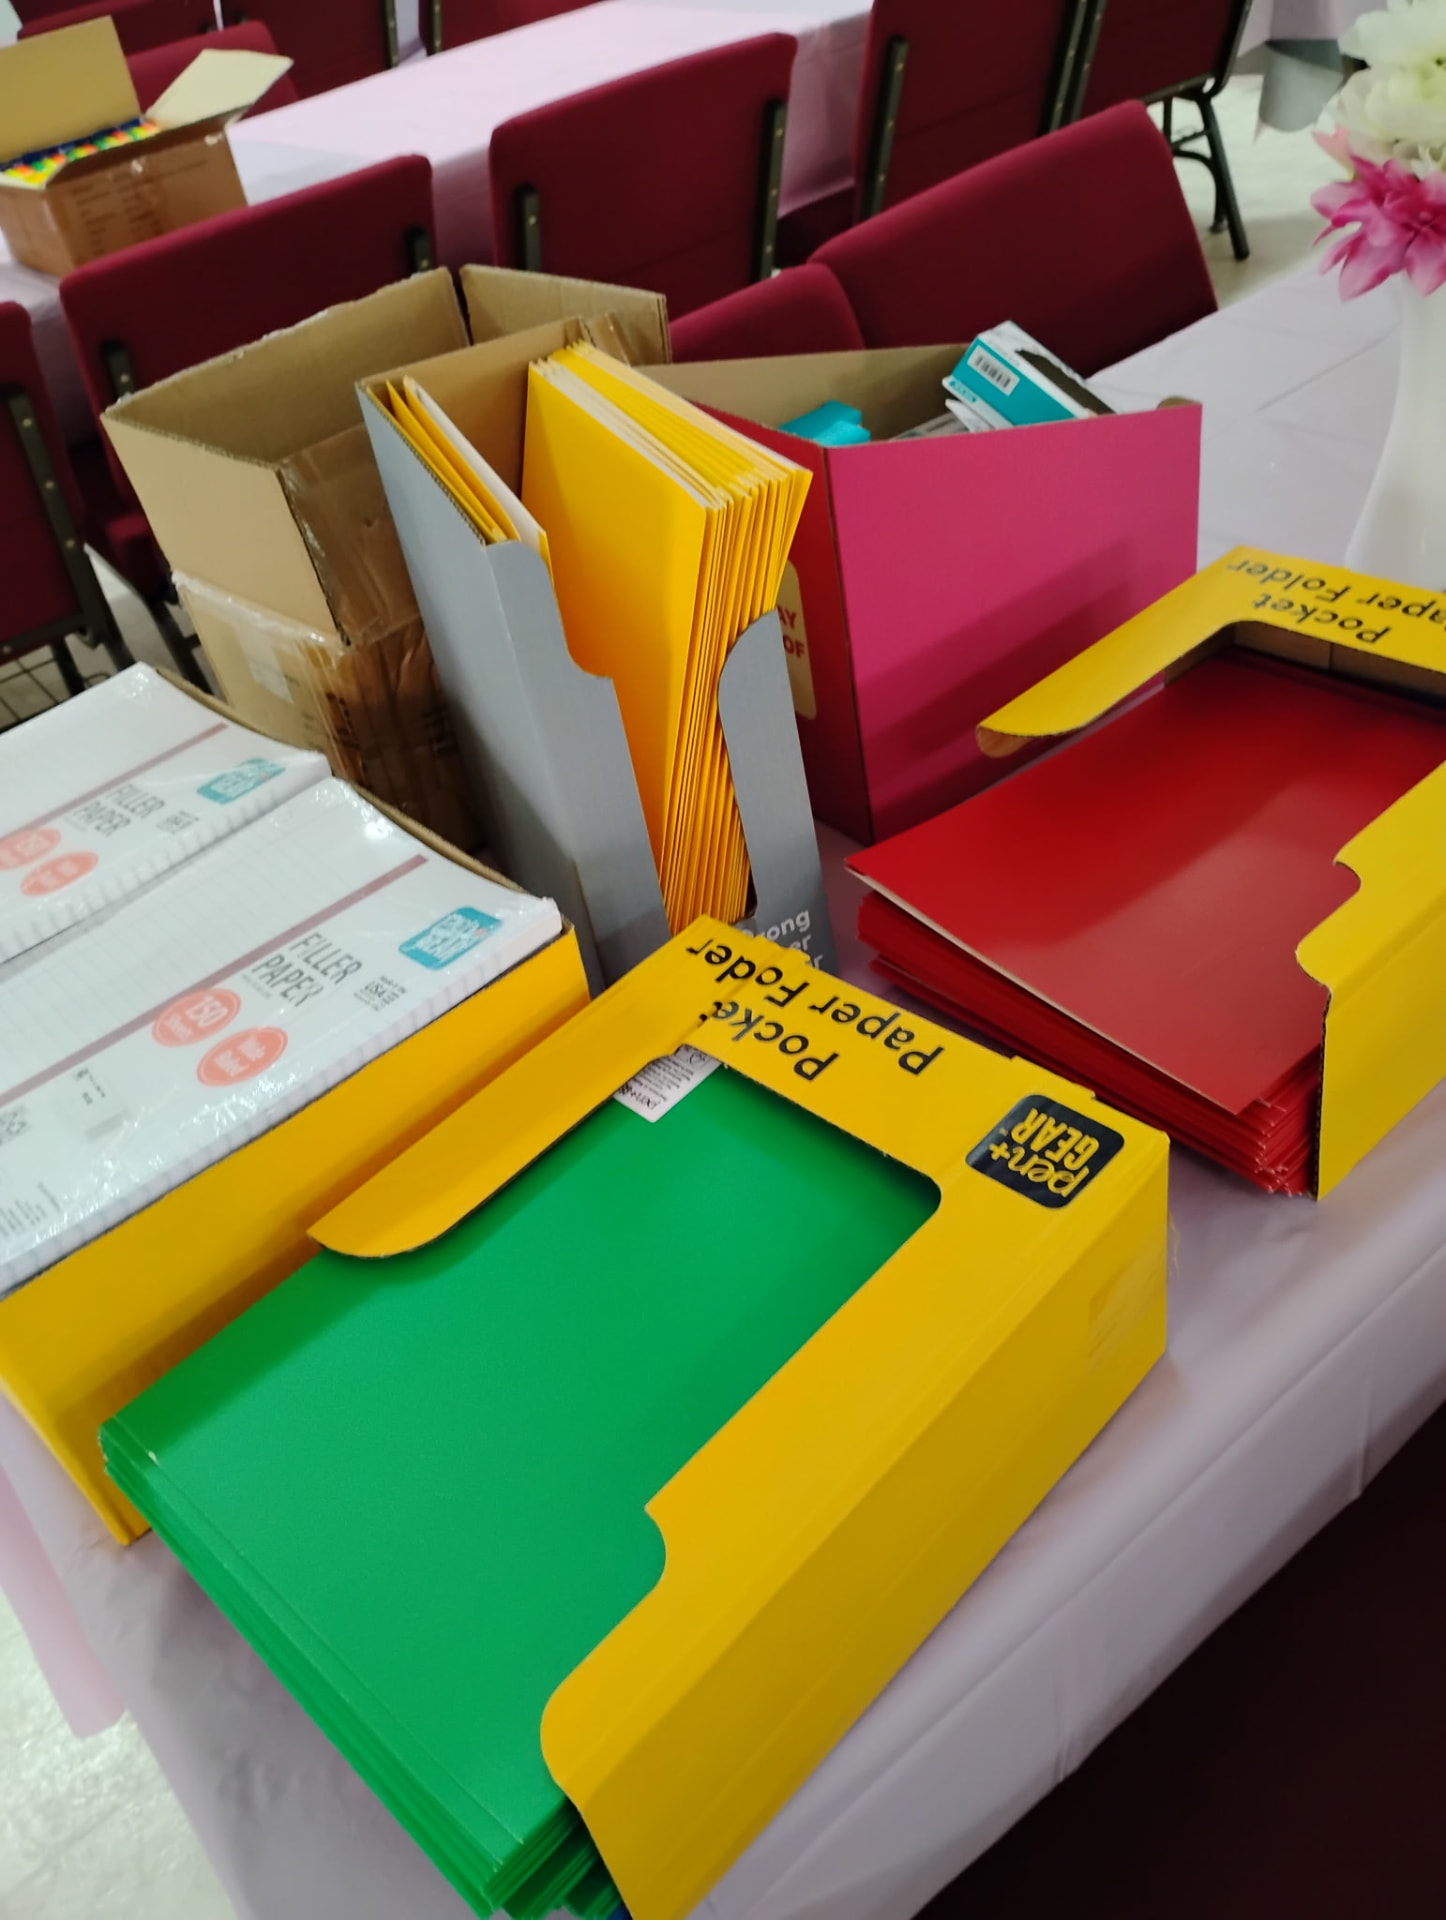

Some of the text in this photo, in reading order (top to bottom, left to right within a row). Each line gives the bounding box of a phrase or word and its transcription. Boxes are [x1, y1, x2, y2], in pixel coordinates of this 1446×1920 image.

[1226, 559, 1446, 632] aper Folder
[1252, 593, 1391, 644] Pocket
[251, 954, 324, 1008] PAPER
[288, 931, 363, 985] FILLER
[185, 995, 228, 1028] 150
[686, 938, 945, 1075] Paper Foder
[1011, 1107, 1100, 1171] GEAR
[989, 1141, 1090, 1198] pen+
